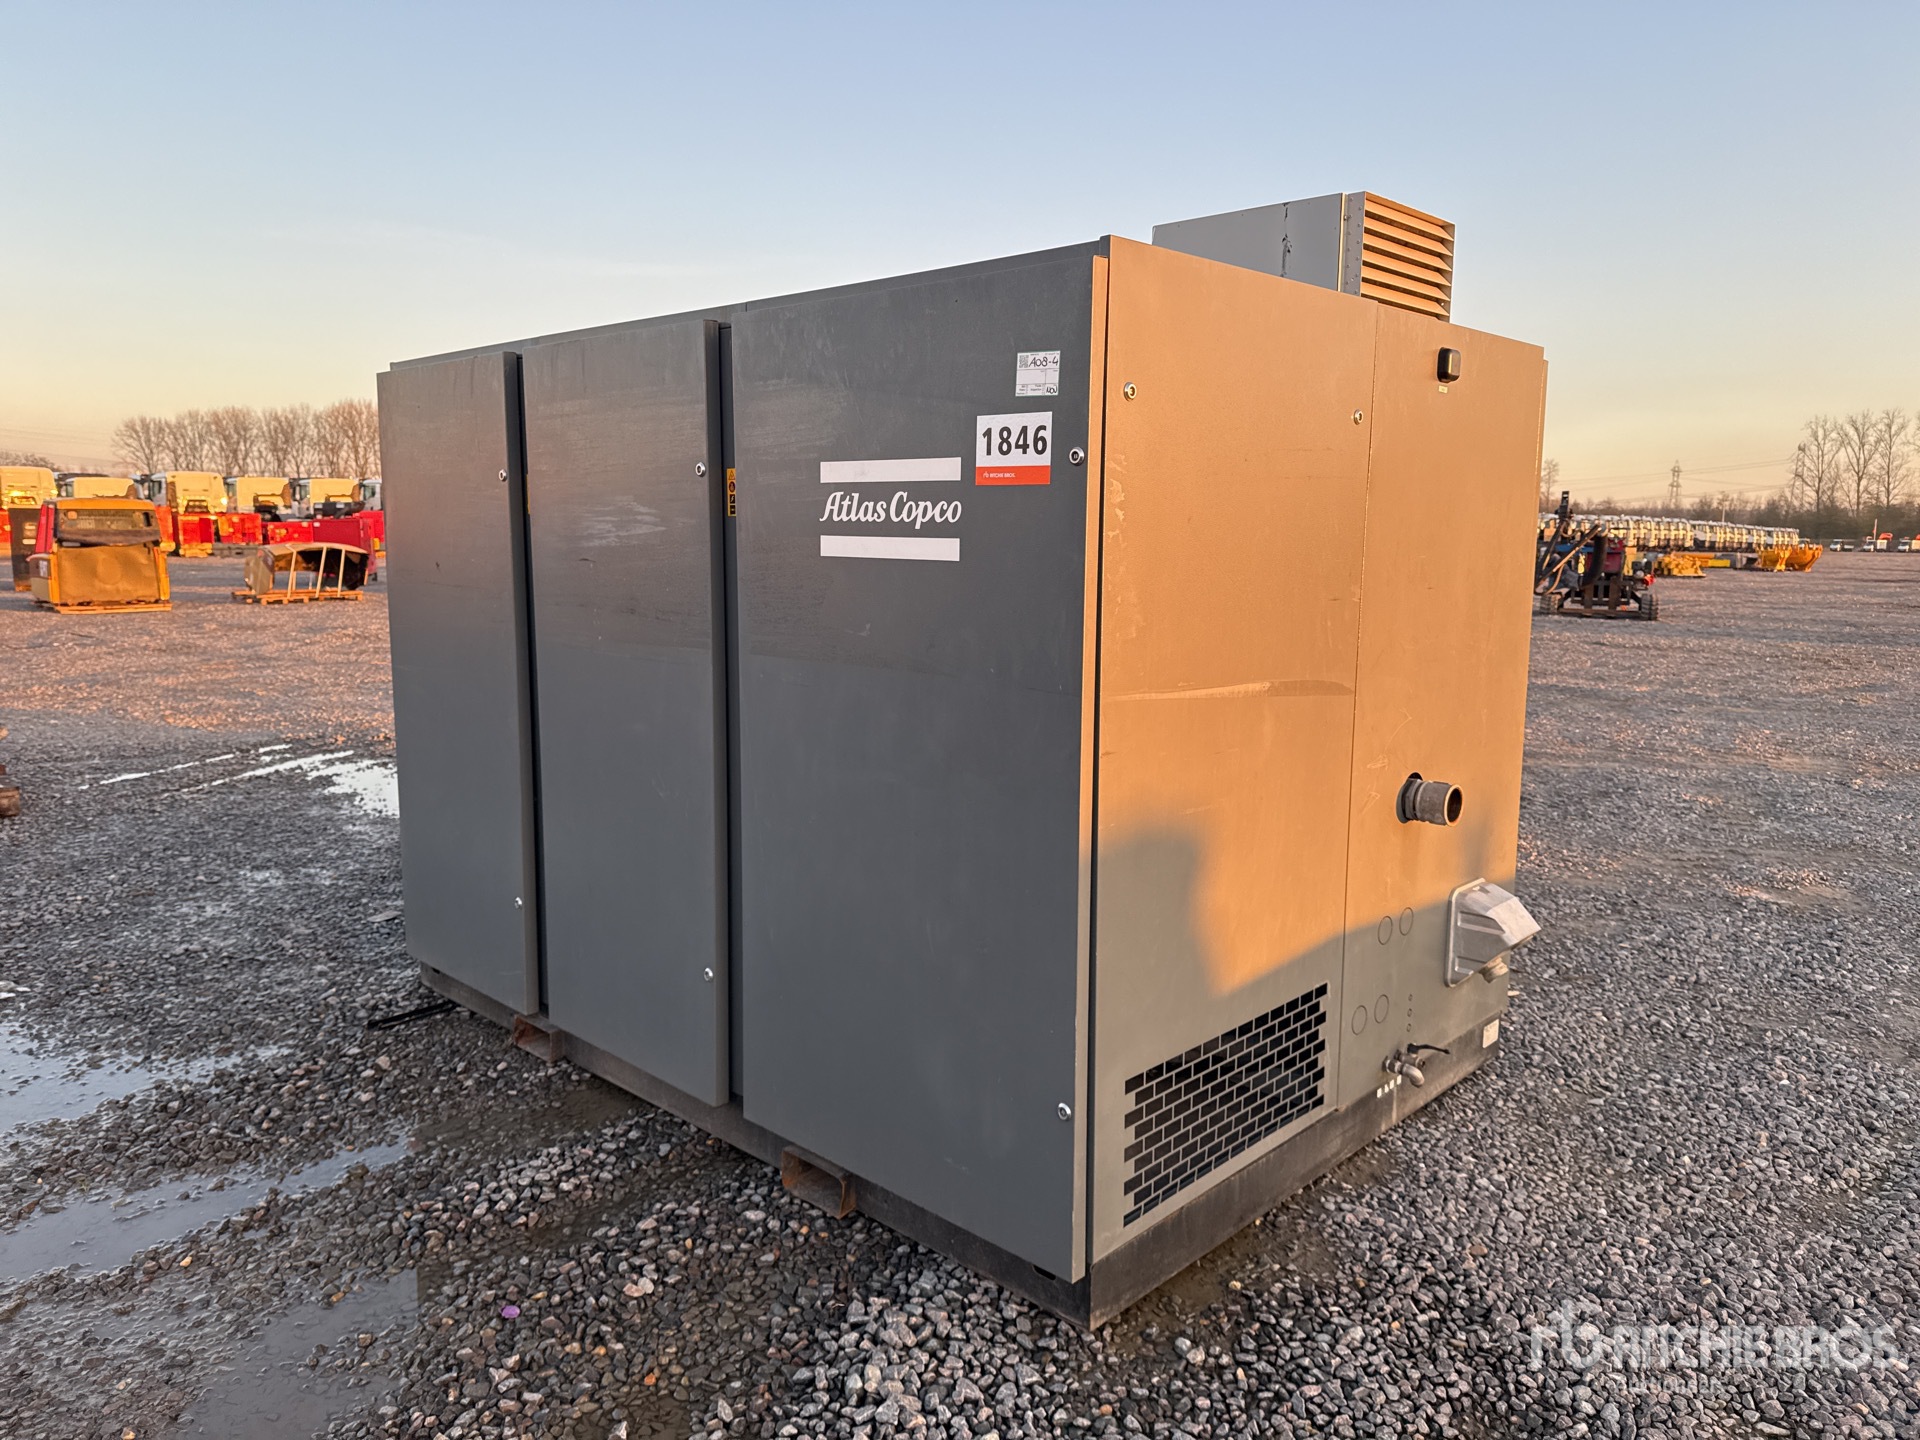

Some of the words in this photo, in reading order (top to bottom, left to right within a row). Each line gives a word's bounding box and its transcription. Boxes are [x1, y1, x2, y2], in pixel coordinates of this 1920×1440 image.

[982, 425, 1048, 456] 1846
[819, 491, 887, 522] Atlas
[889, 491, 962, 529] Copco
